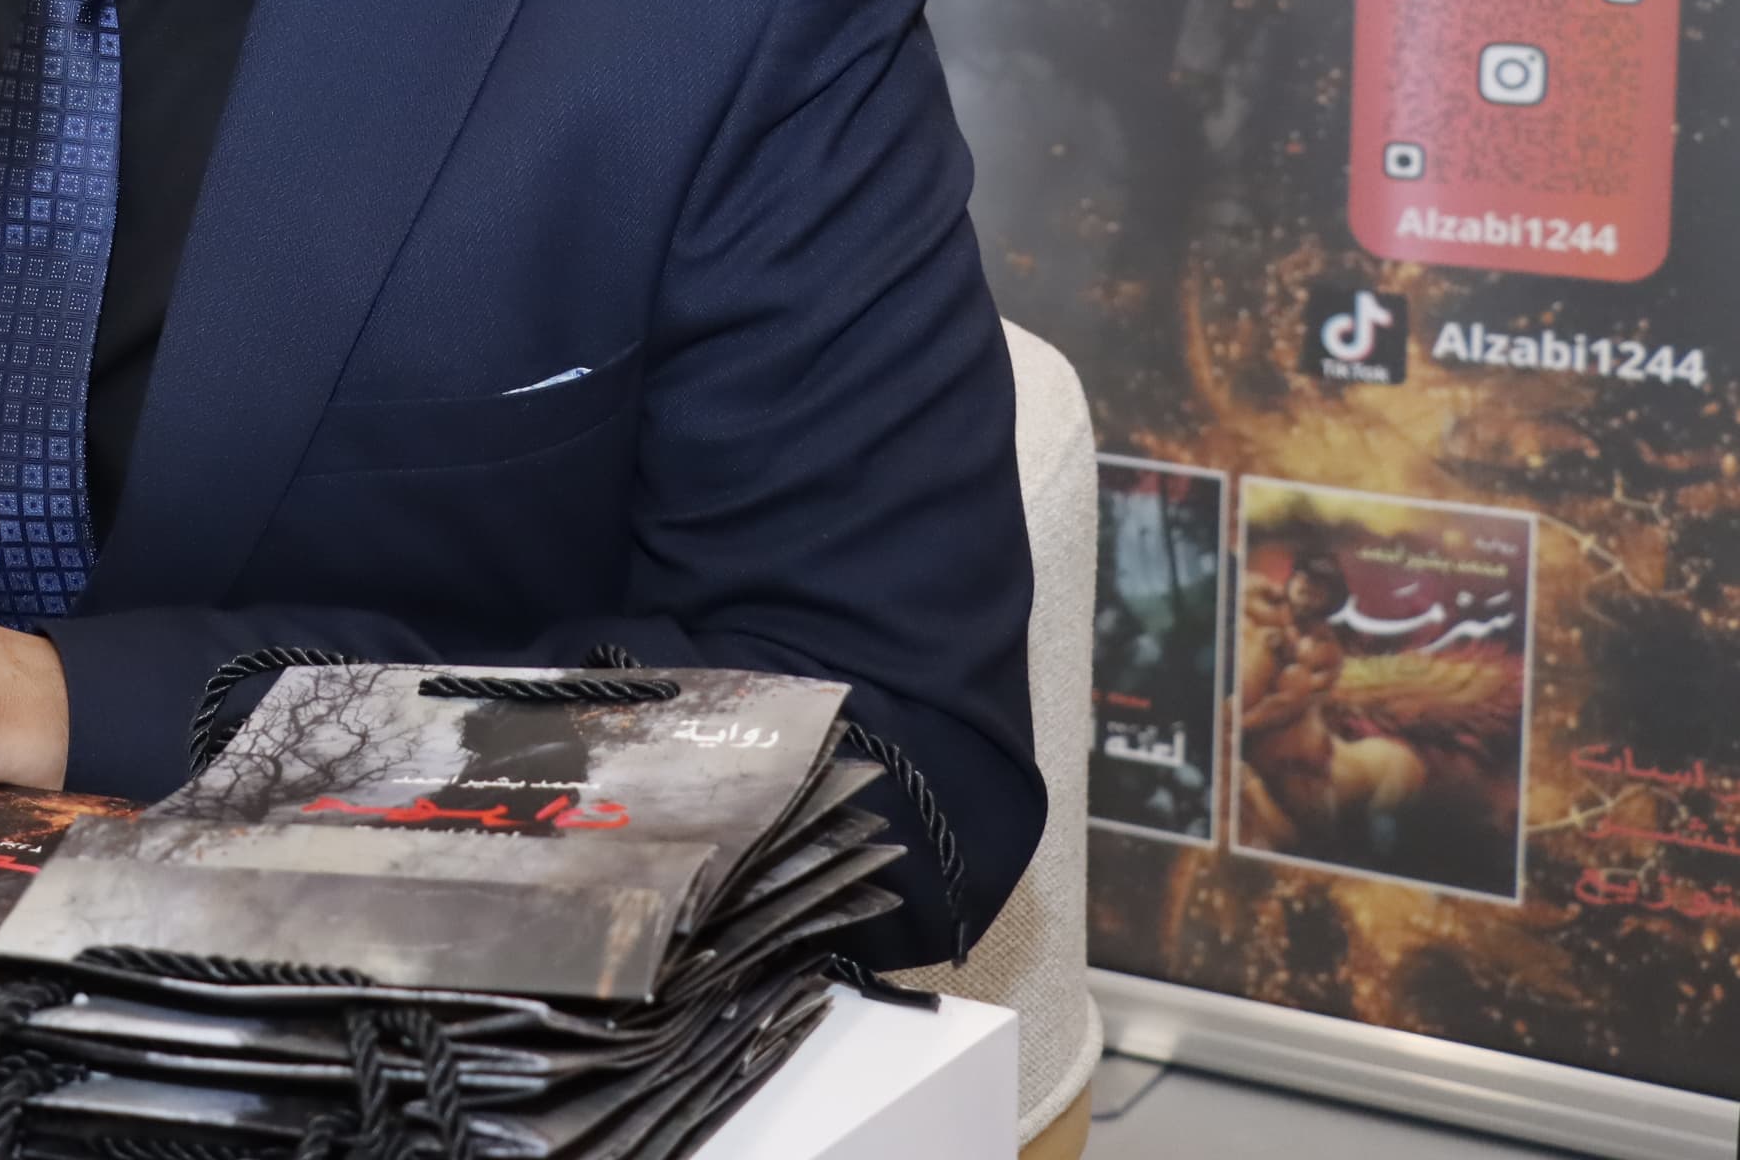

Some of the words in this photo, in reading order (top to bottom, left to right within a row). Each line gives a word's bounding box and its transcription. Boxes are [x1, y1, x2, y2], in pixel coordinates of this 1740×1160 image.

[1395, 206, 1620, 256] Alzabi1244
[1432, 322, 1708, 387] Alzabi1244
[673, 720, 779, 749] رواية
